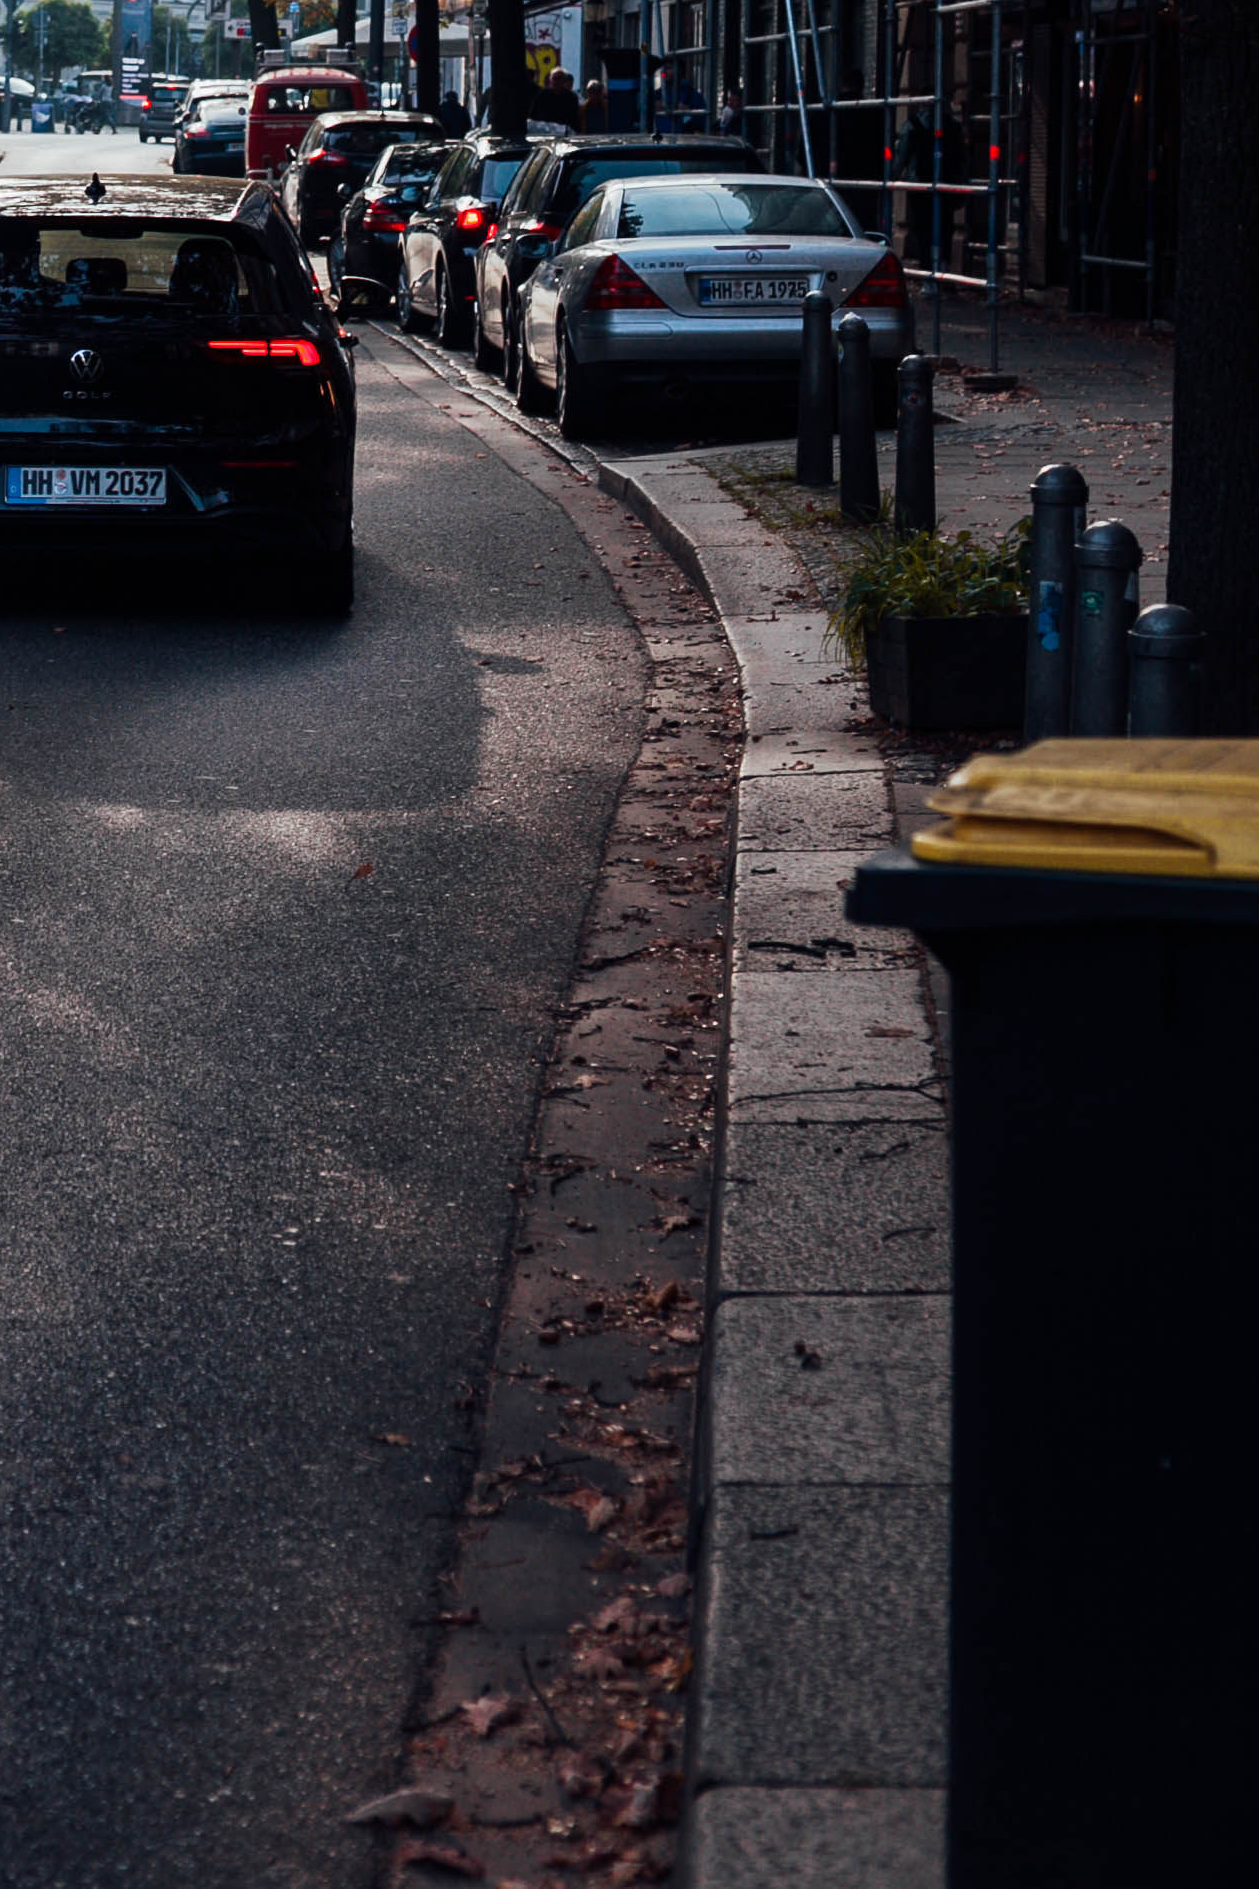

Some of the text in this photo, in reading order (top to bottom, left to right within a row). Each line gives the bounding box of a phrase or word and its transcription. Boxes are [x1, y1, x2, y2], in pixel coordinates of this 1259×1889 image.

[711, 280, 807, 300] HH FA 1975
[62, 390, 112, 400] GOLF
[22, 469, 164, 497] HH VM 2037
